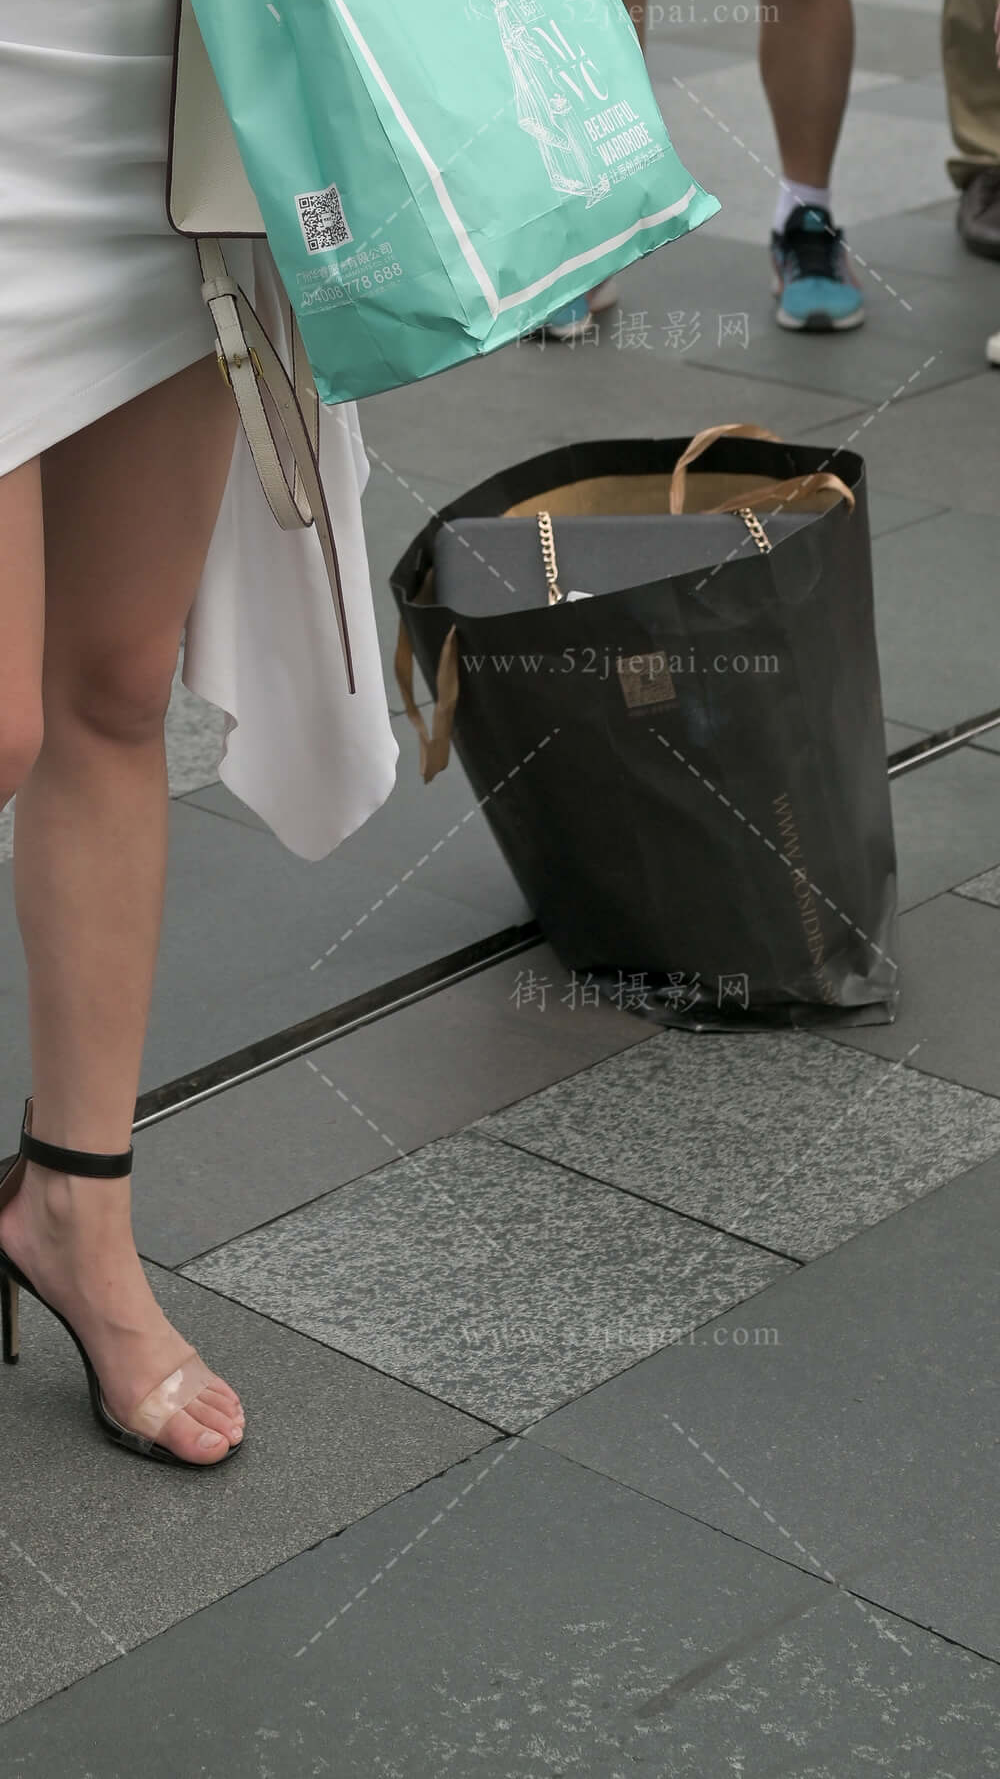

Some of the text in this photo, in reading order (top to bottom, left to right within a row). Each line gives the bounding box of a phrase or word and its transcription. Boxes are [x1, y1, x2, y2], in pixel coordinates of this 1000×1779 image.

[583, 99, 640, 141] BEAUTIFUL
[596, 121, 654, 166] WARDROBE
[343, 275, 372, 297] 778
[373, 262, 402, 284] 688
